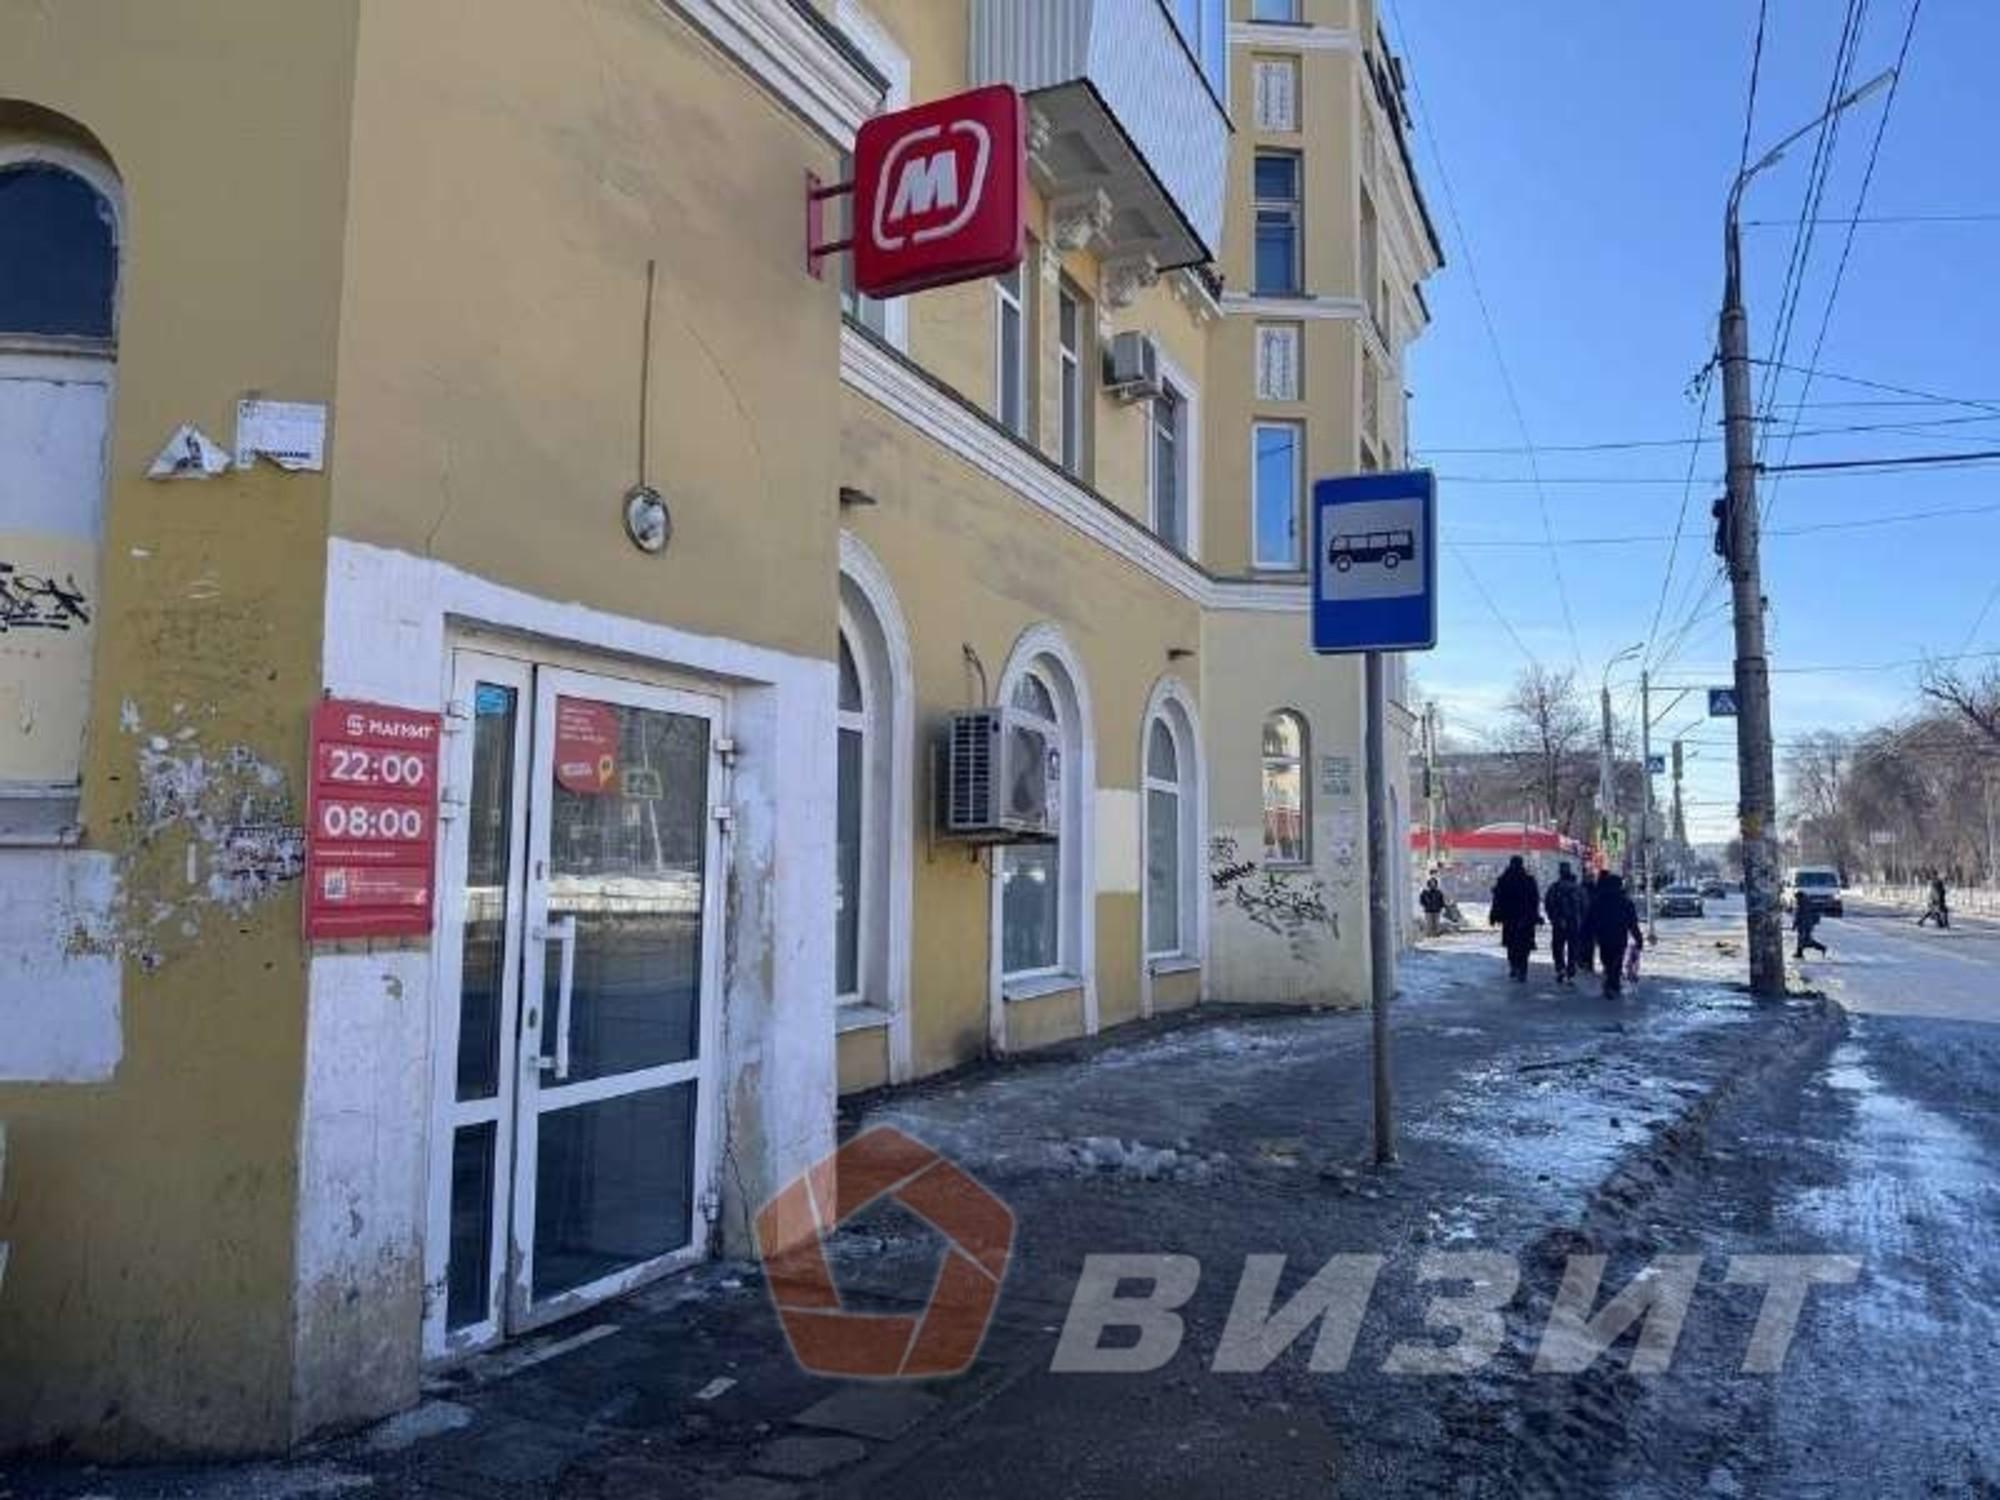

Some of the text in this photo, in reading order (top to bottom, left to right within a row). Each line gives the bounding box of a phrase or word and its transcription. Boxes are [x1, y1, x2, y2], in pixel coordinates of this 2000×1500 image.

[369, 720, 434, 739] МАГНИТ
[331, 749, 423, 784] 22:00
[324, 805, 421, 838] 08:00
